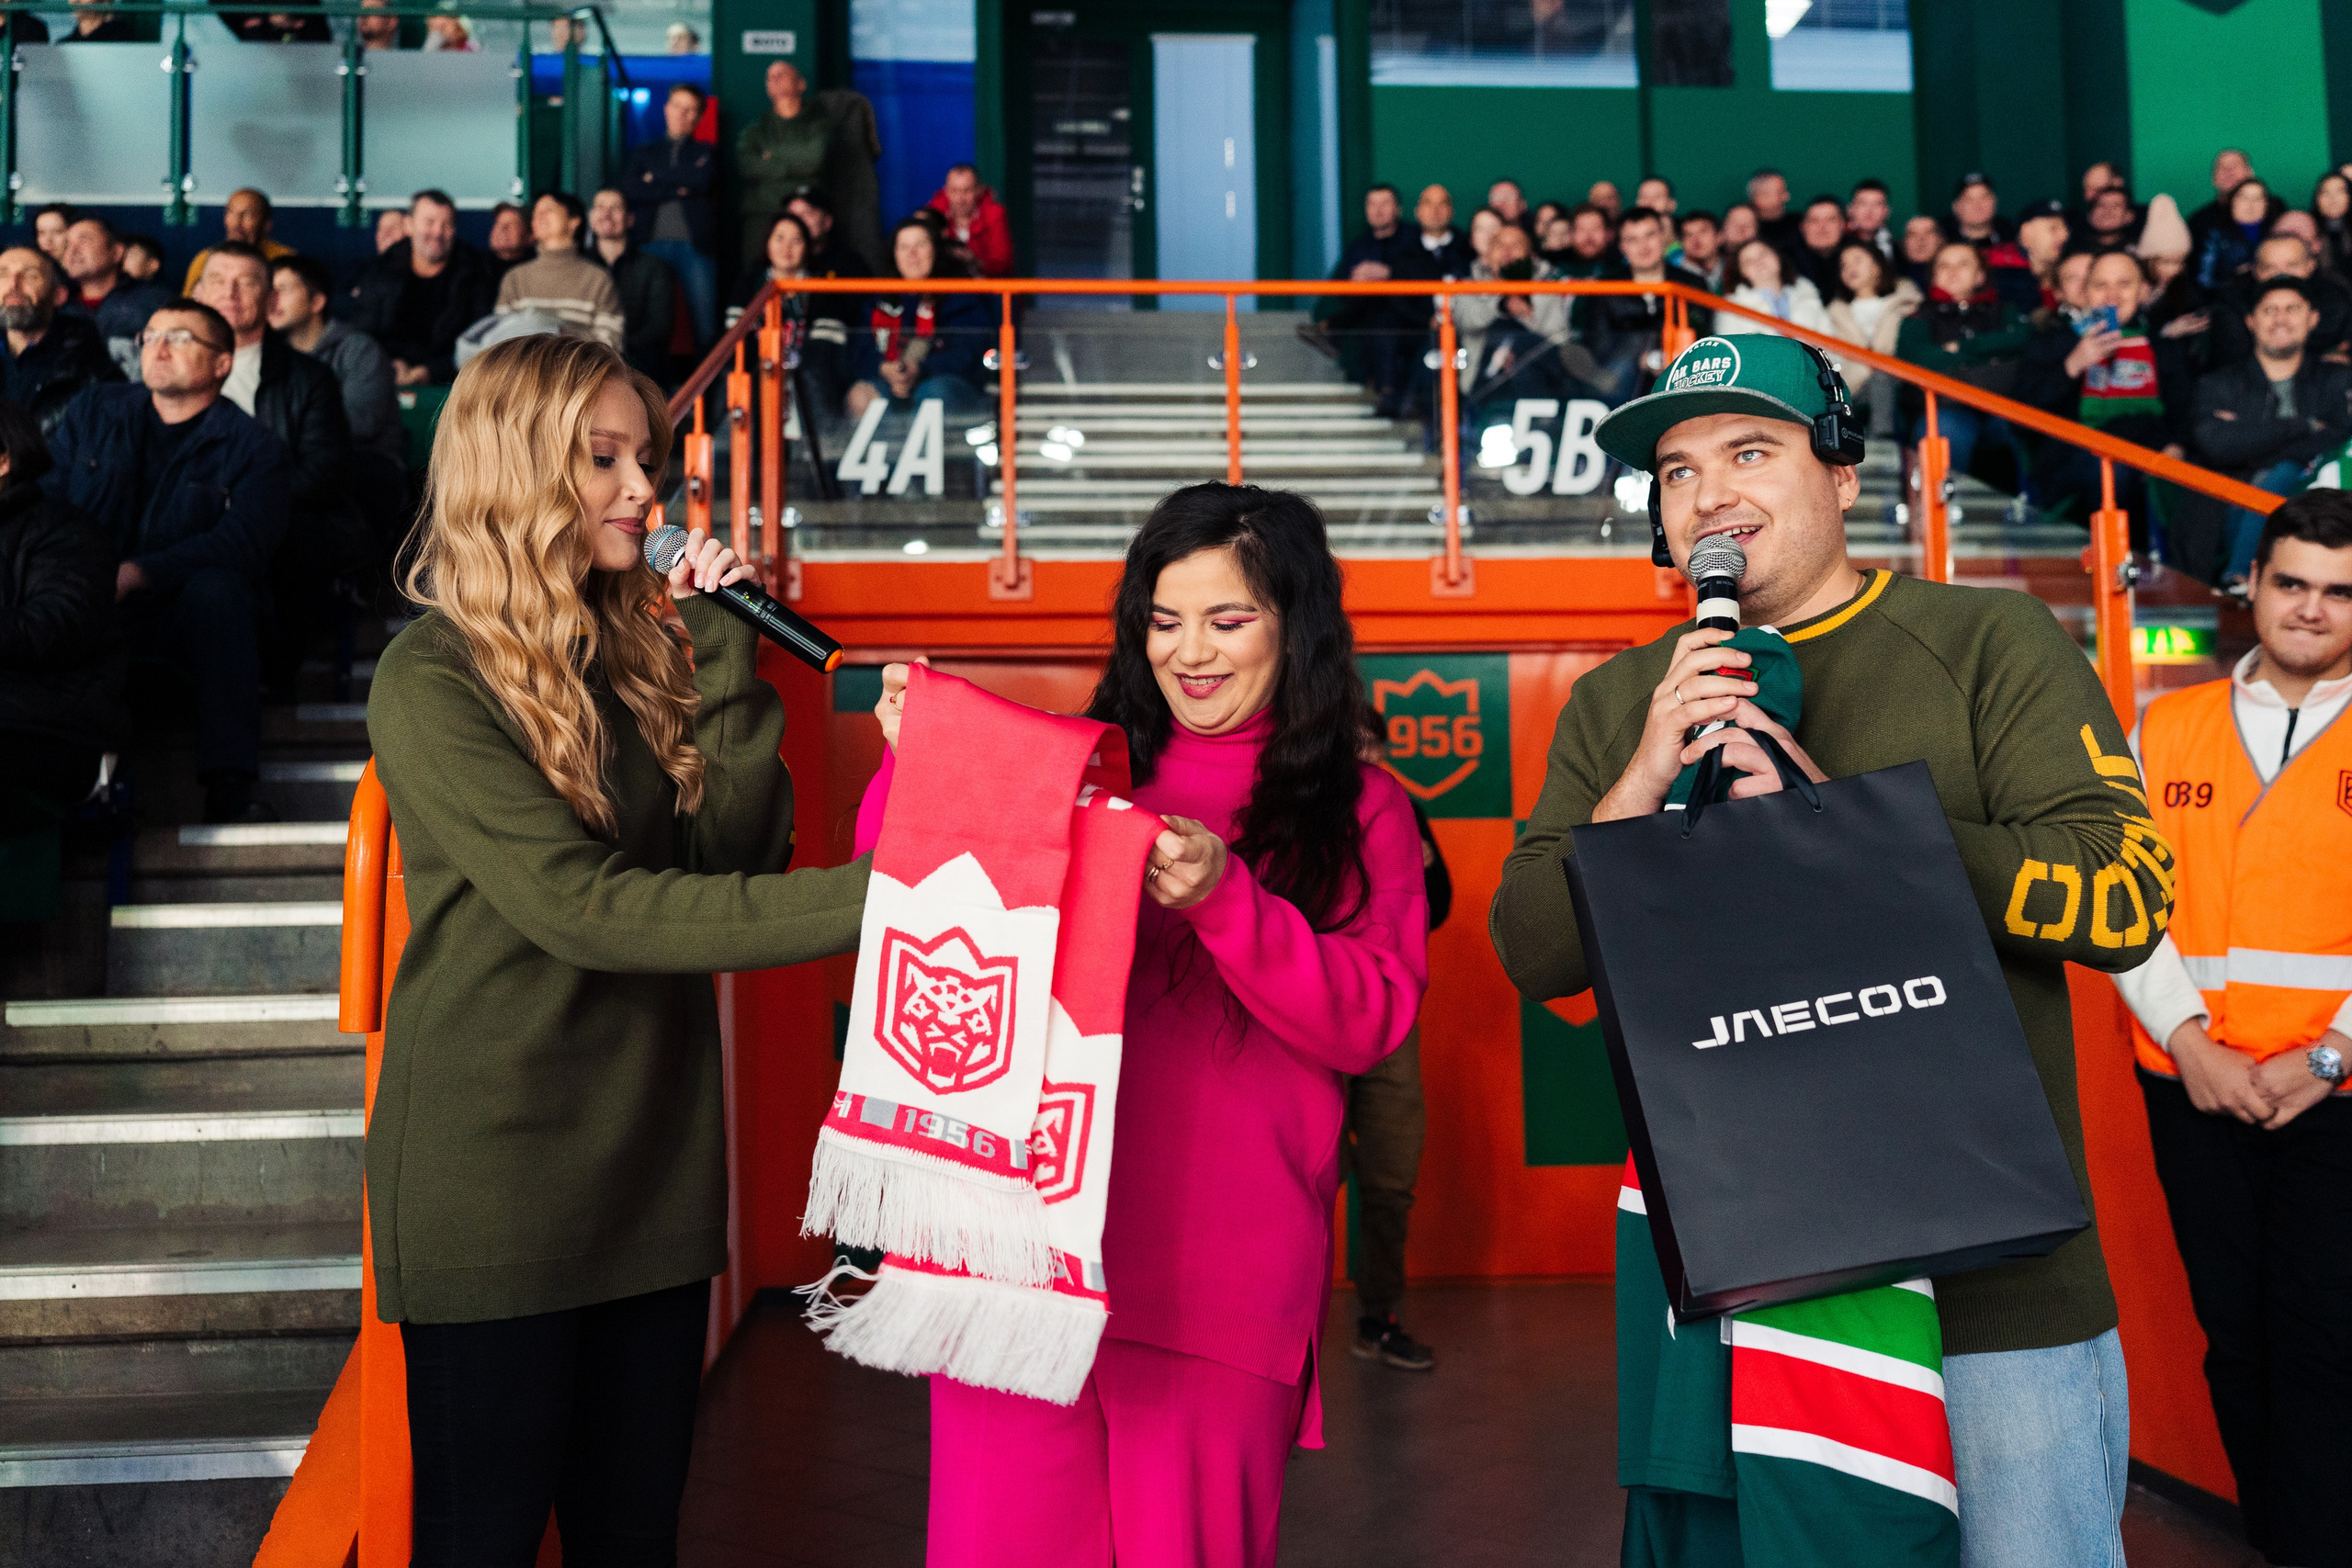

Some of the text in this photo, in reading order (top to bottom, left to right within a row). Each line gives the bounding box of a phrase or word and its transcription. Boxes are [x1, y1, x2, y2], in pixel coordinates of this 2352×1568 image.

[1671, 356, 1732, 384] AK BARS
[1673, 368, 1727, 389] HOCKEY
[1843, 403, 1852, 416] 3
[836, 398, 944, 495] 4A
[1502, 398, 1611, 495] 5B
[1387, 716, 1484, 758] 956
[1691, 975, 1947, 1050] JAECOO
[903, 1108, 997, 1158] 1956
